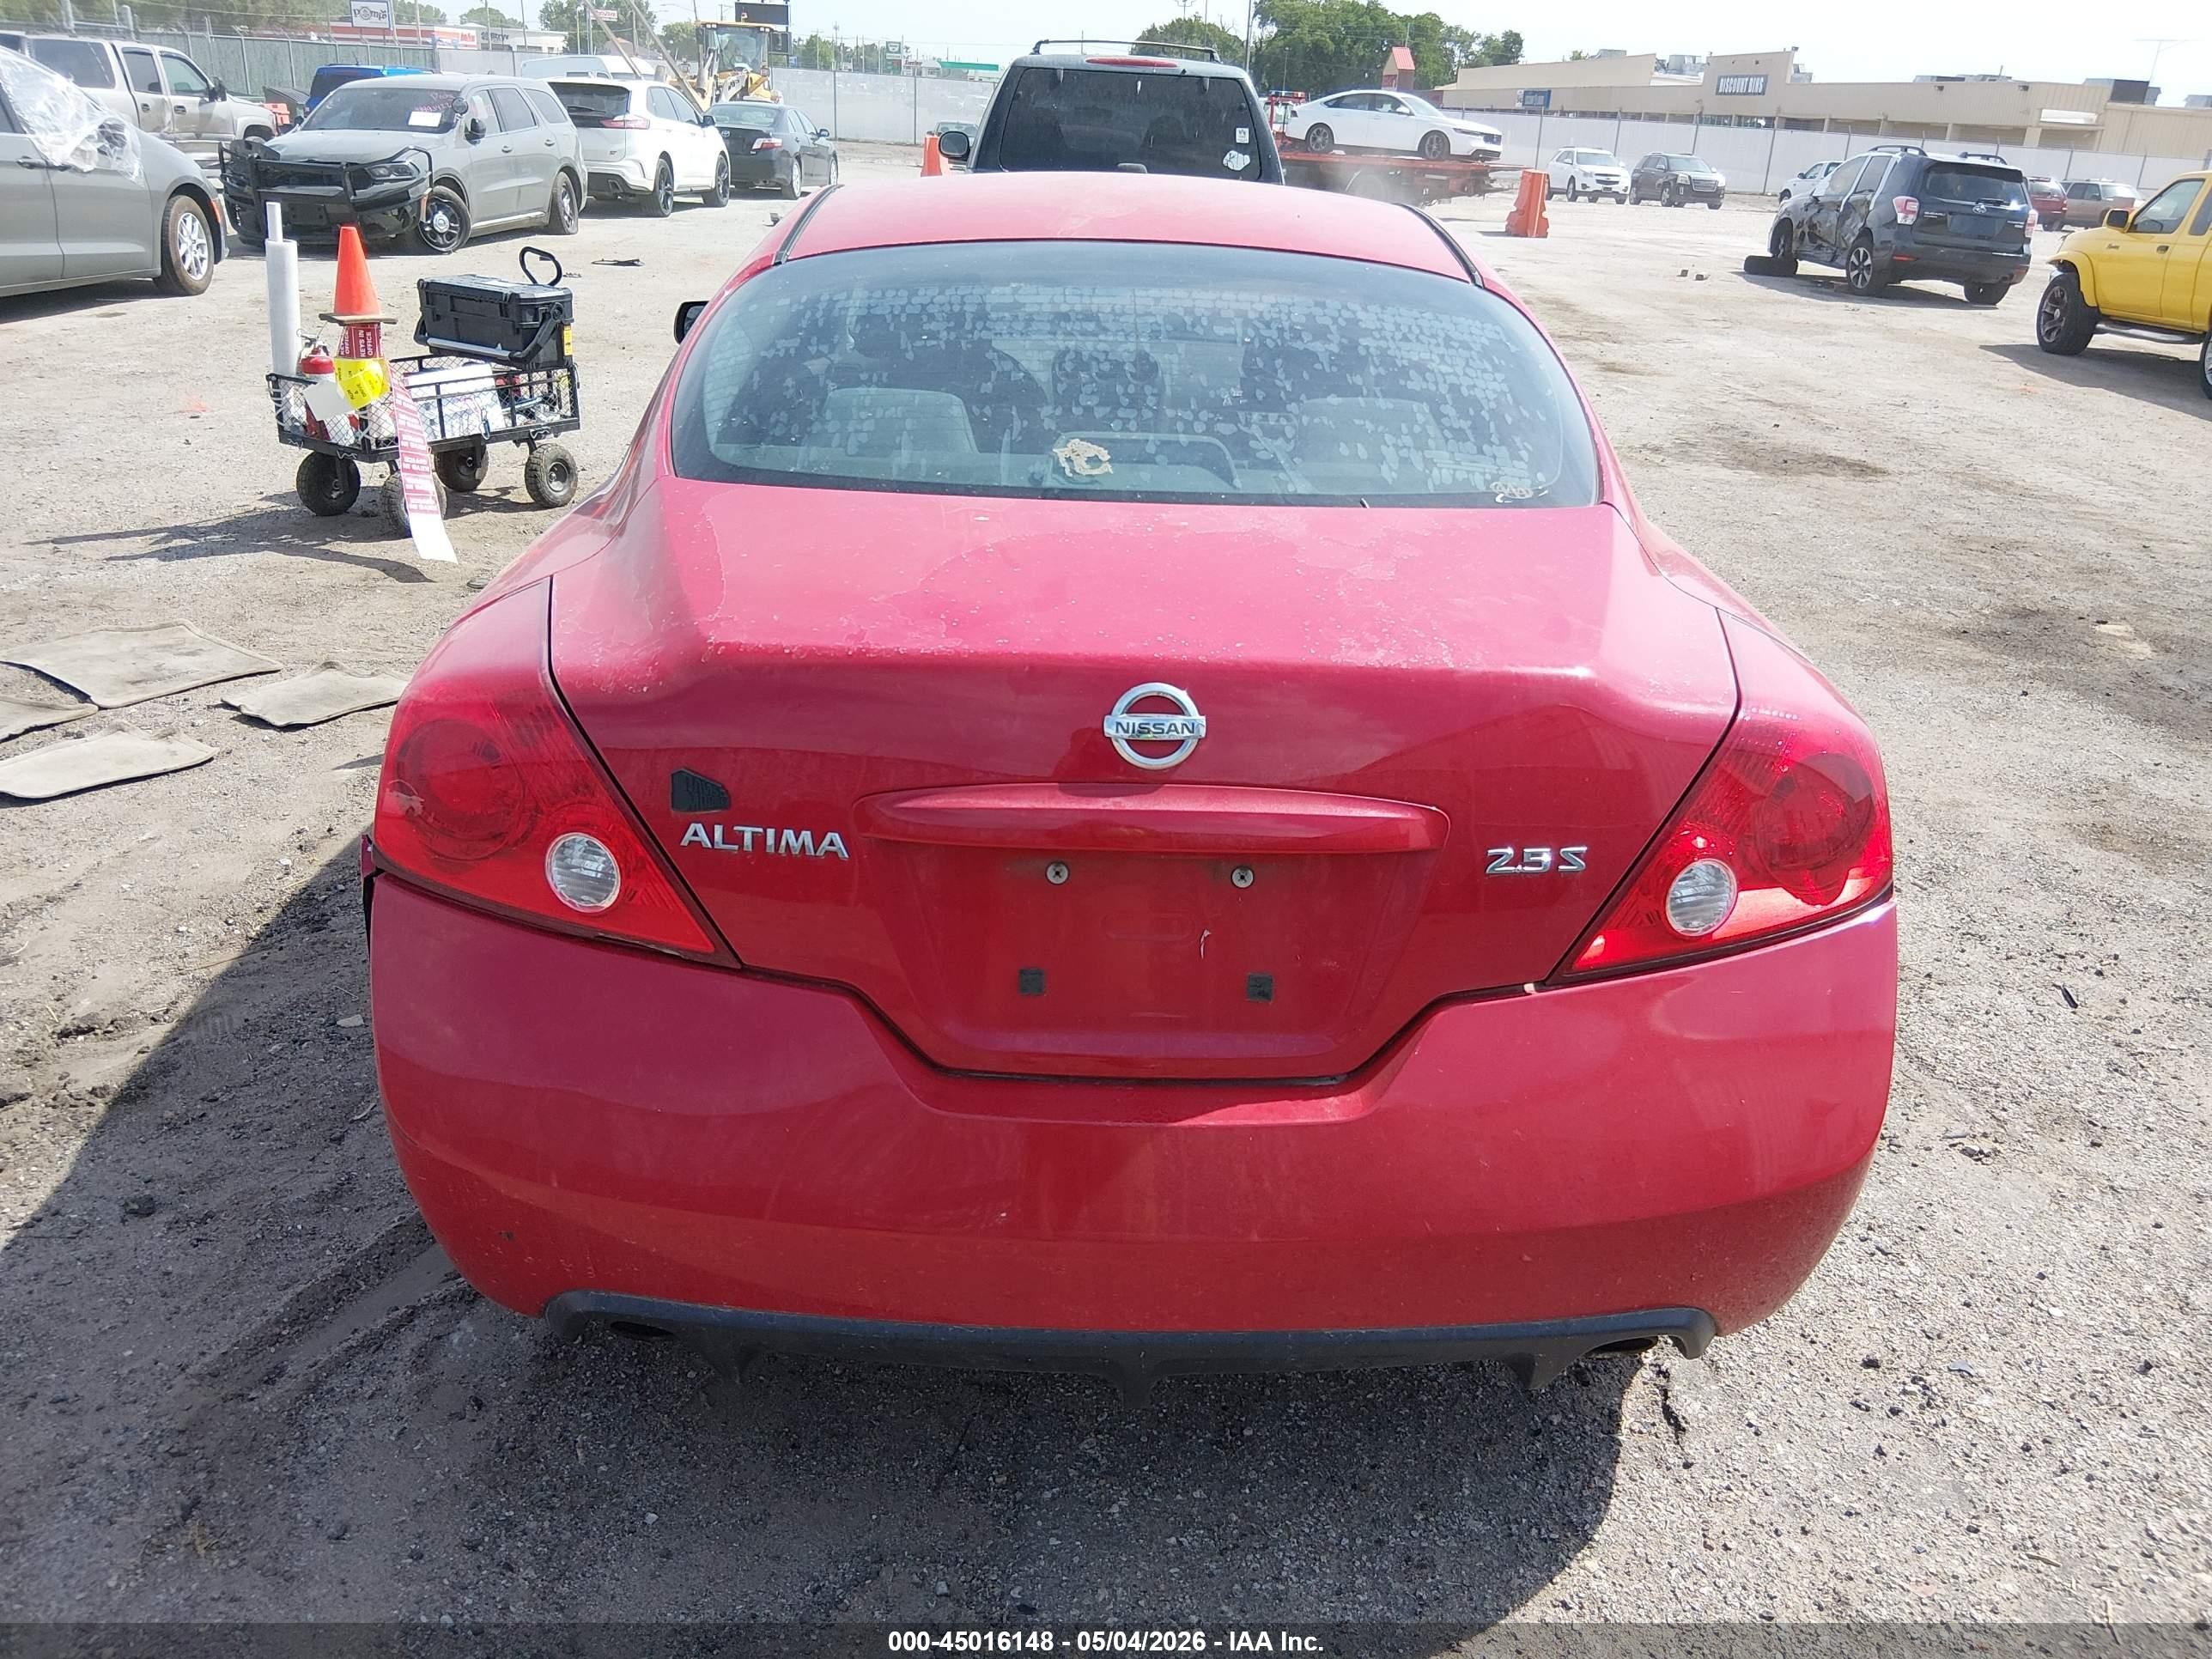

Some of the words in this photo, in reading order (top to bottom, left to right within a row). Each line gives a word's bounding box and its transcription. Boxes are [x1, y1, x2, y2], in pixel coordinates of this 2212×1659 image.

[1115, 721, 1194, 735] NISSAN
[680, 823, 849, 859] ALTIMA
[1486, 847, 1551, 873] 2.5
[1558, 846, 1587, 872] S
